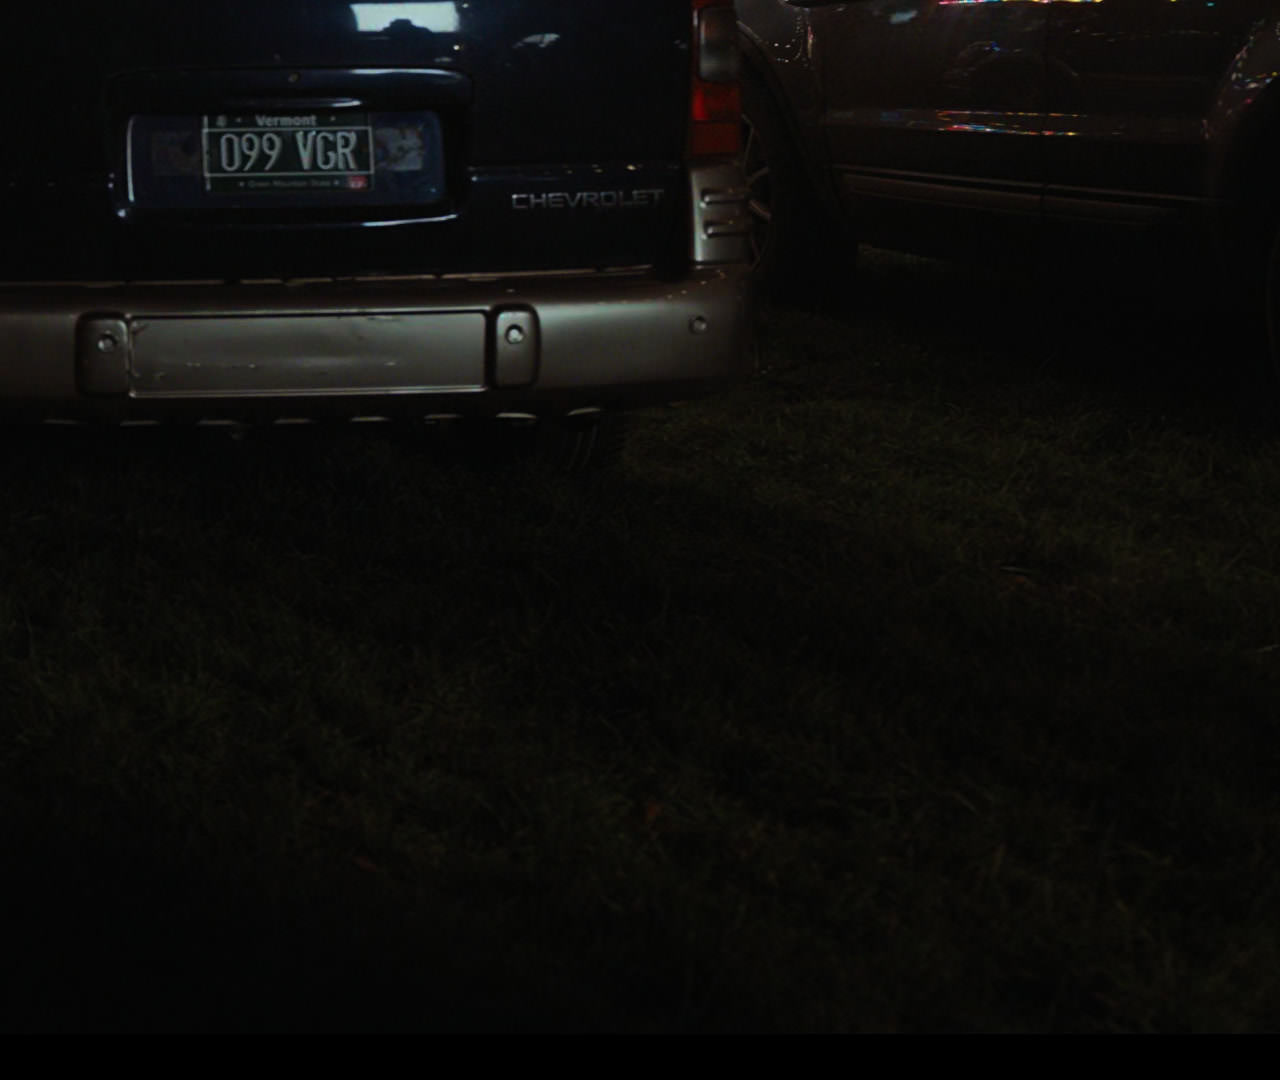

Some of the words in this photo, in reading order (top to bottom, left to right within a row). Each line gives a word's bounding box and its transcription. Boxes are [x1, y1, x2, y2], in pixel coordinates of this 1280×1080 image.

[256, 114, 317, 127] Vermont
[220, 133, 282, 172] 099
[295, 130, 358, 171] VGR
[512, 189, 665, 209] CHEVROLET
